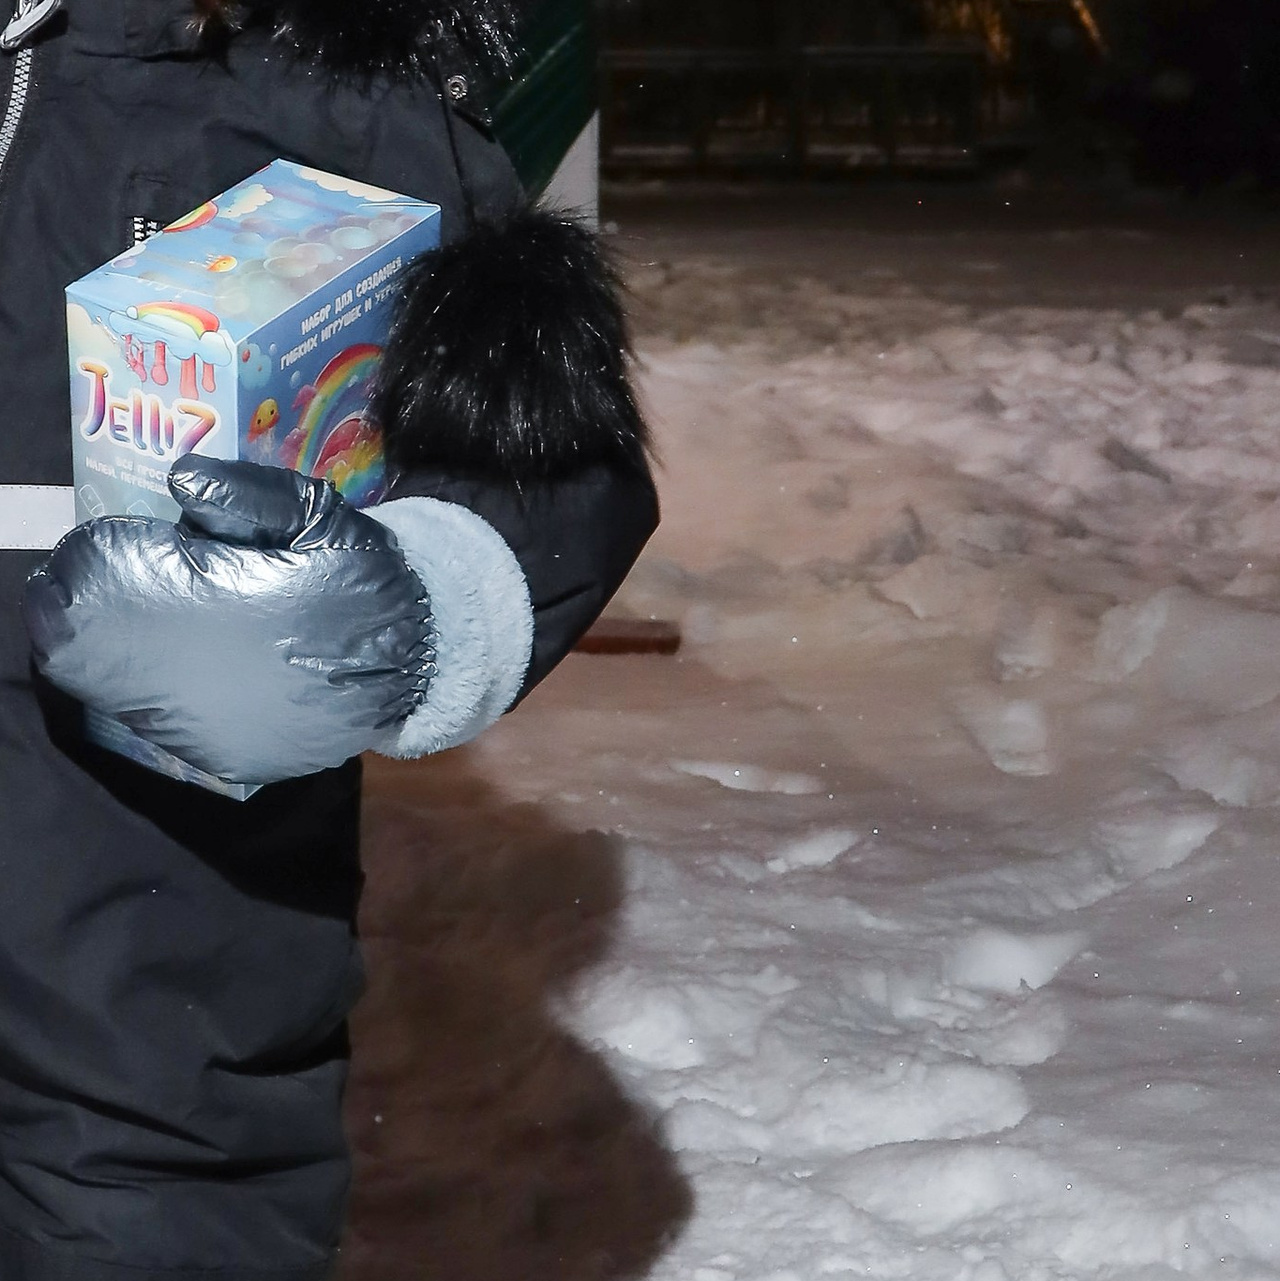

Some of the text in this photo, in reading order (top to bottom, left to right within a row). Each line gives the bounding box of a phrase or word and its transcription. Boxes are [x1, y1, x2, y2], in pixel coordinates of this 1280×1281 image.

[301, 304, 331, 335] НАБОР
[335, 289, 353, 314] ДЛЯ
[280, 333, 318, 370] ГИБКИХ
[321, 304, 361, 342] ИГРУШЕК
[137, 464, 169, 483] ПРОСТ
